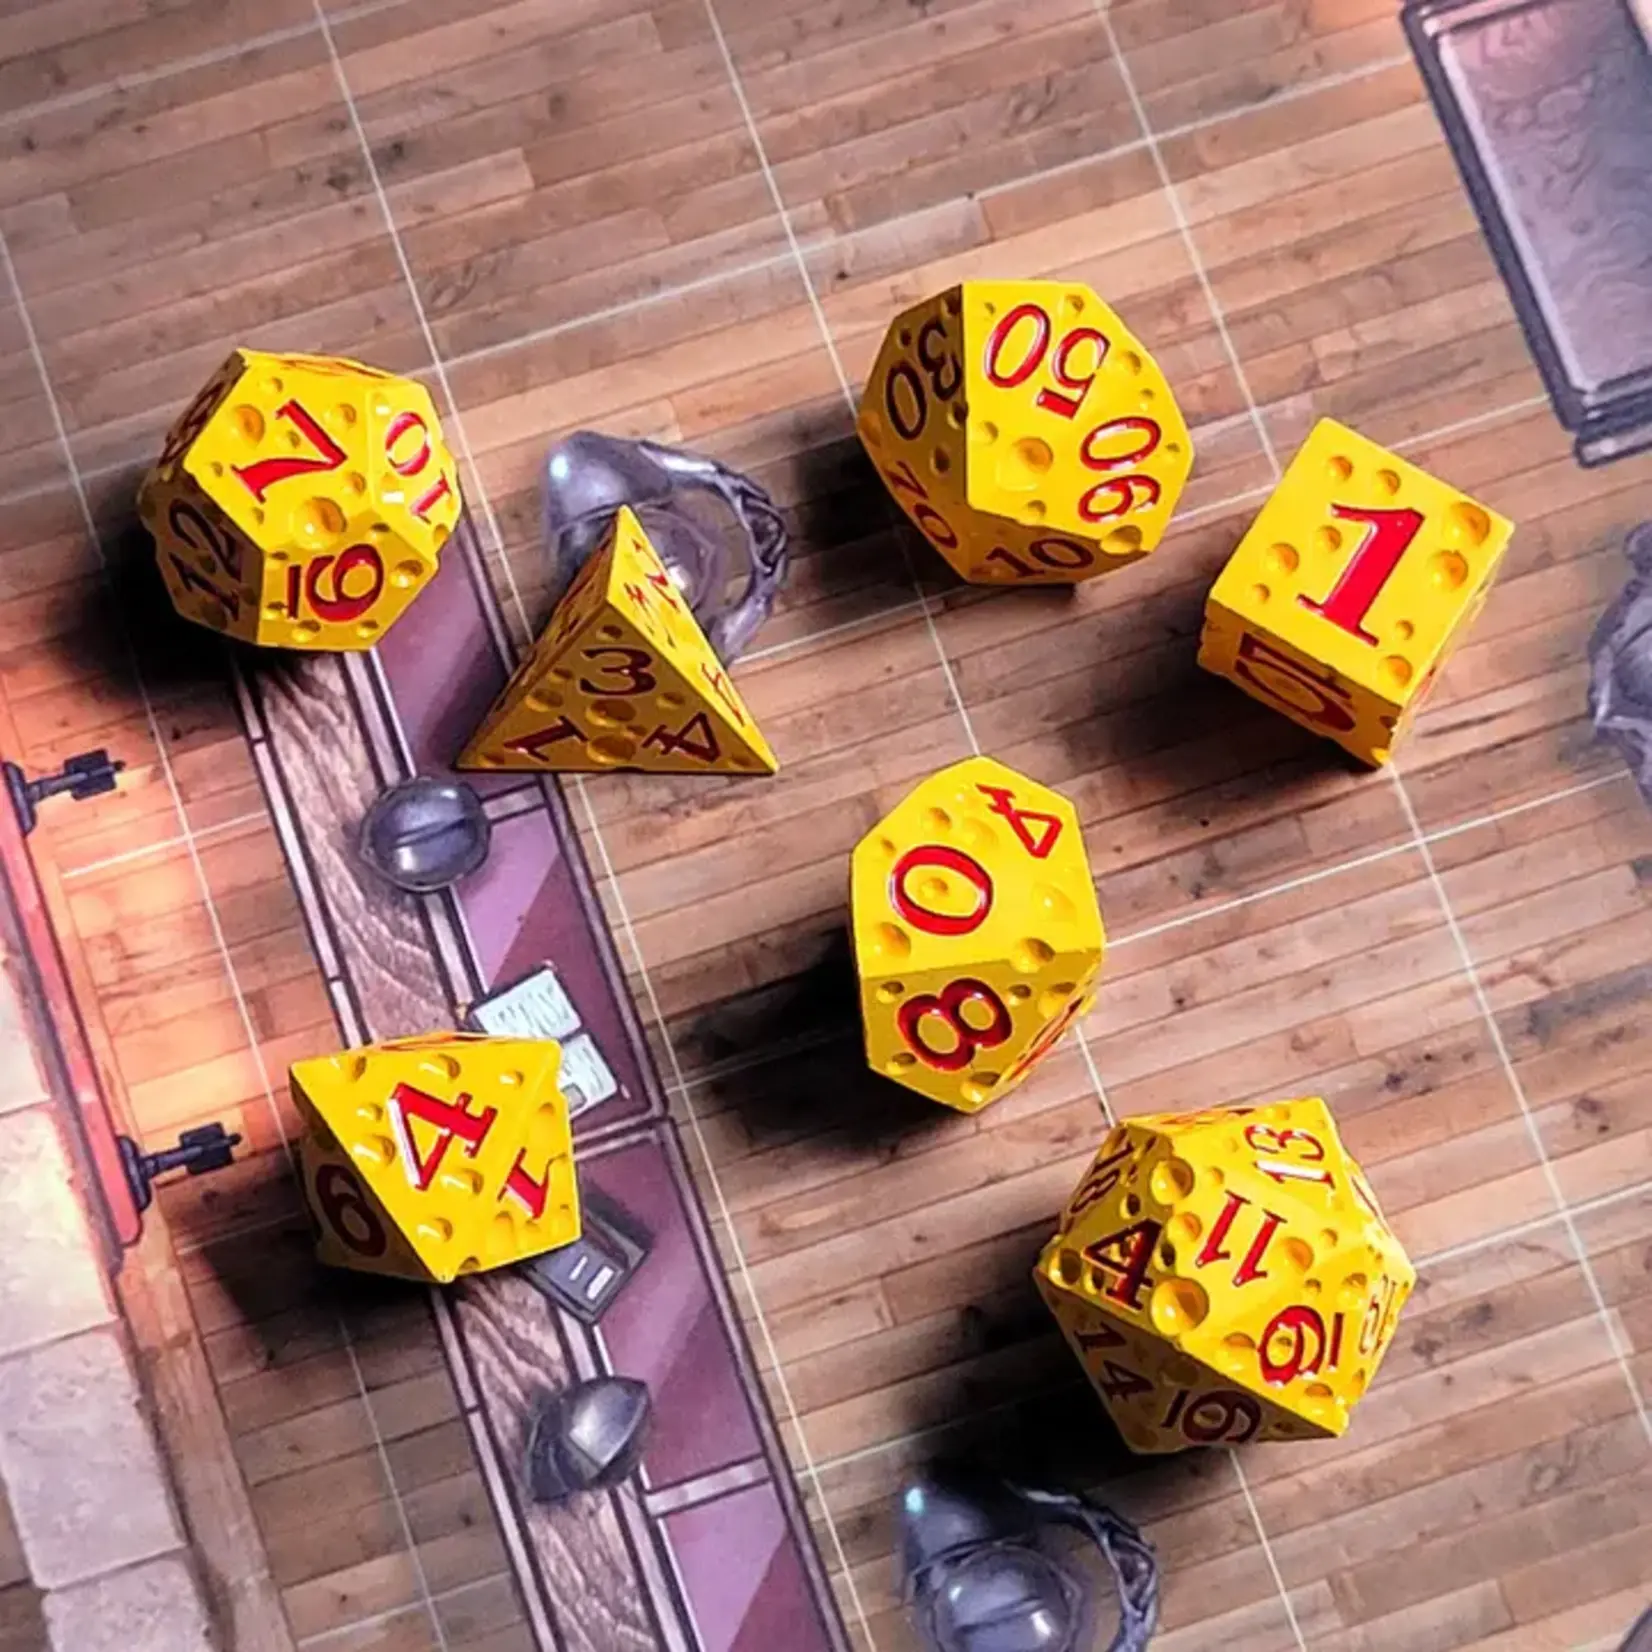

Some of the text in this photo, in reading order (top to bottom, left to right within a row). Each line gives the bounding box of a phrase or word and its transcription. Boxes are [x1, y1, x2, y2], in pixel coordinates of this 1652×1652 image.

[886, 318, 962, 441] 30
[984, 303, 1110, 420] 50
[232, 399, 347, 503] 7
[385, 411, 452, 525] 10
[885, 460, 958, 549] 70
[168, 499, 243, 622] 12
[985, 537, 1095, 577] 10
[1297, 502, 1426, 647] 1
[580, 645, 657, 697] 3
[1234, 632, 1356, 731] 5
[504, 715, 588, 762] 1
[642, 712, 721, 763] 4
[975, 784, 1063, 859] 4
[888, 844, 994, 937] 0
[896, 977, 1013, 1073] 8
[387, 1082, 498, 1191] 4
[497, 1147, 566, 1220] 1
[1069, 1139, 1134, 1214] 18
[1244, 1124, 1337, 1189] 13
[316, 1163, 387, 1257] 6
[1196, 1189, 1287, 1287] 11
[1080, 1217, 1162, 1312] 4
[1074, 1323, 1153, 1402] 14
